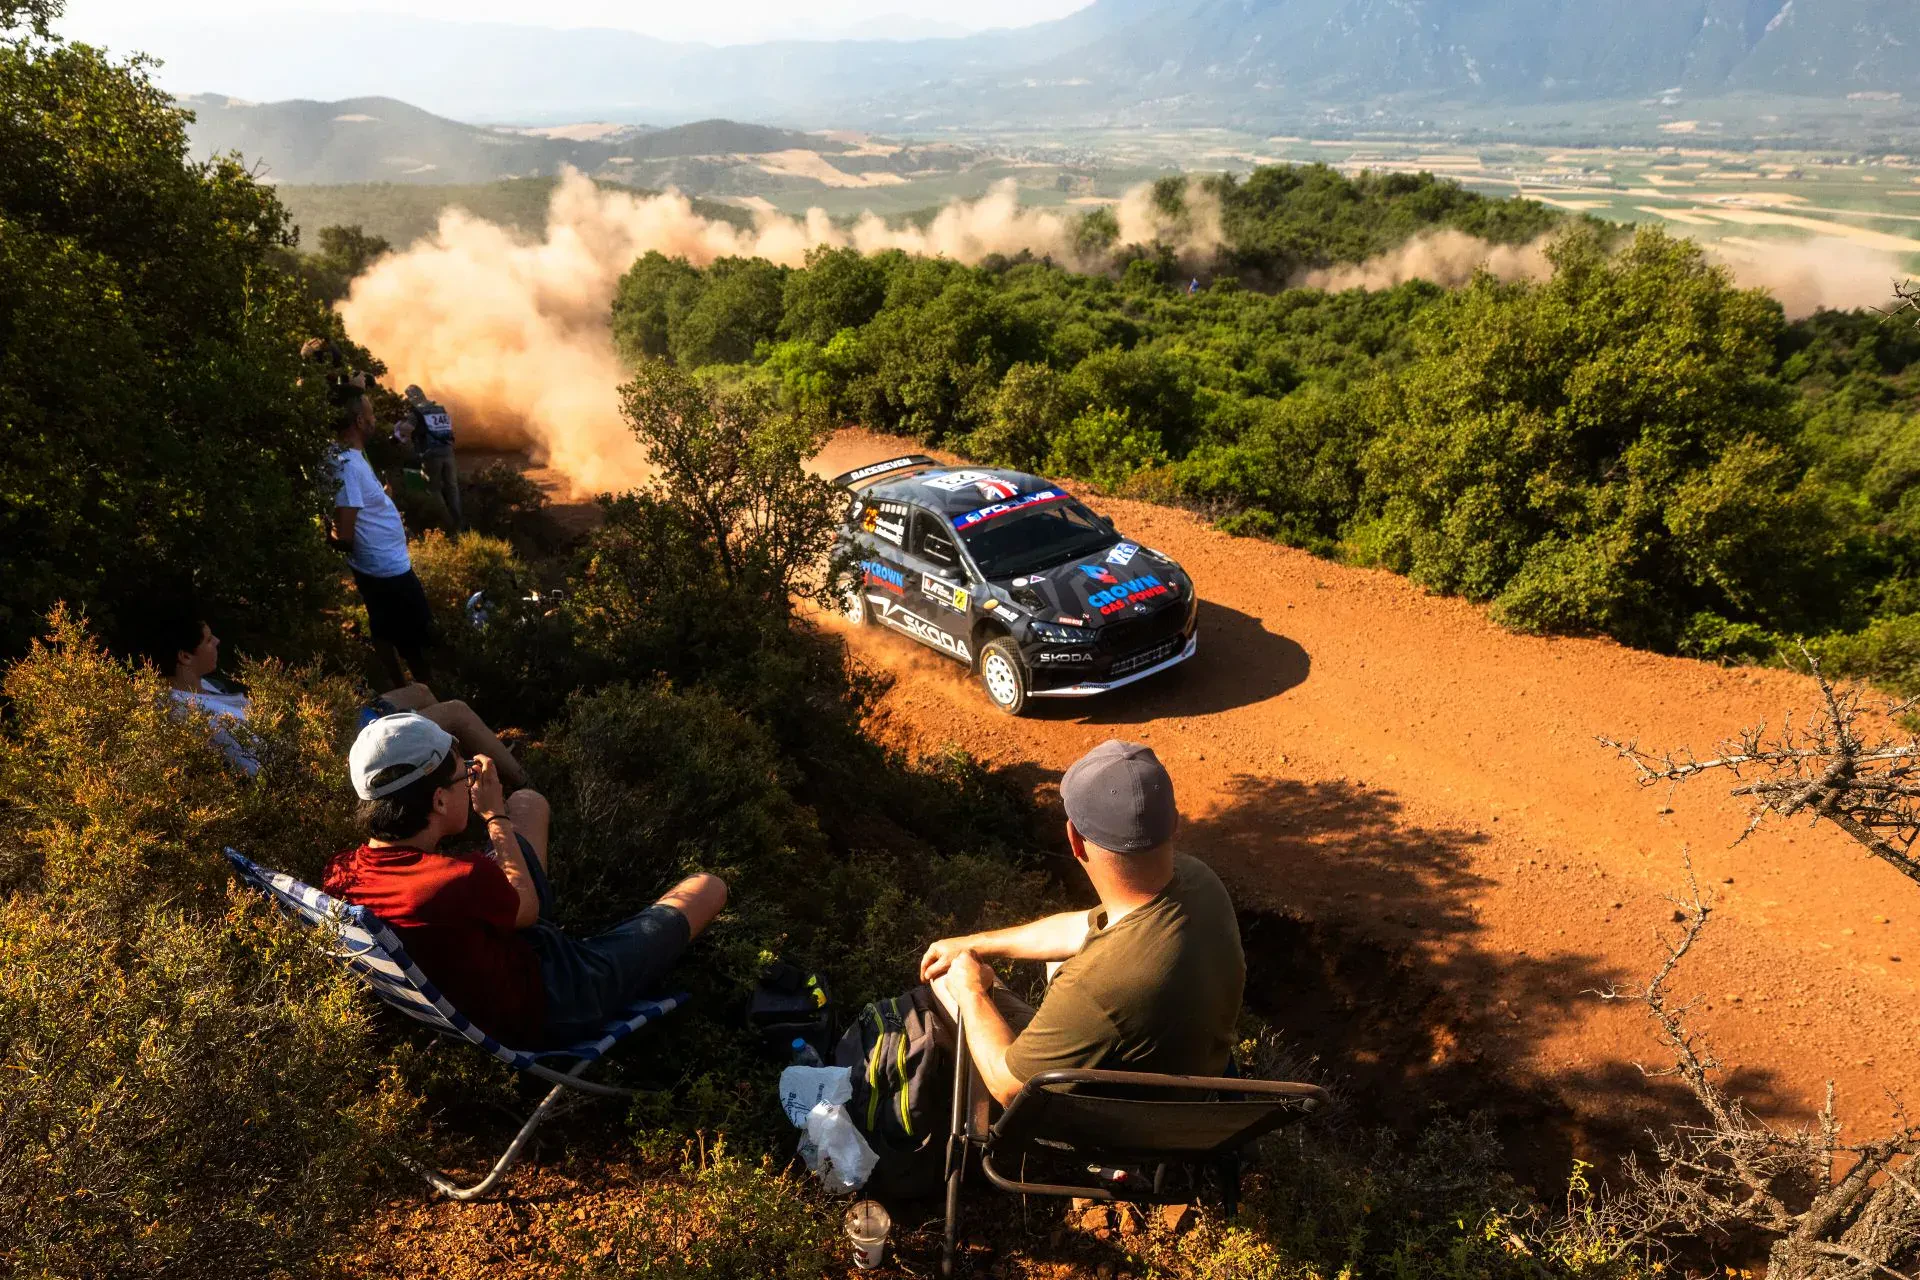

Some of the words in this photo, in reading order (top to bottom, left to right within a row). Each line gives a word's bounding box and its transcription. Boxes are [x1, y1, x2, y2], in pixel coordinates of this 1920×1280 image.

[871, 561, 904, 588] CROWN
[1088, 574, 1161, 608] CROWN
[1100, 598, 1126, 615] GAS
[1127, 585, 1168, 603] POWER
